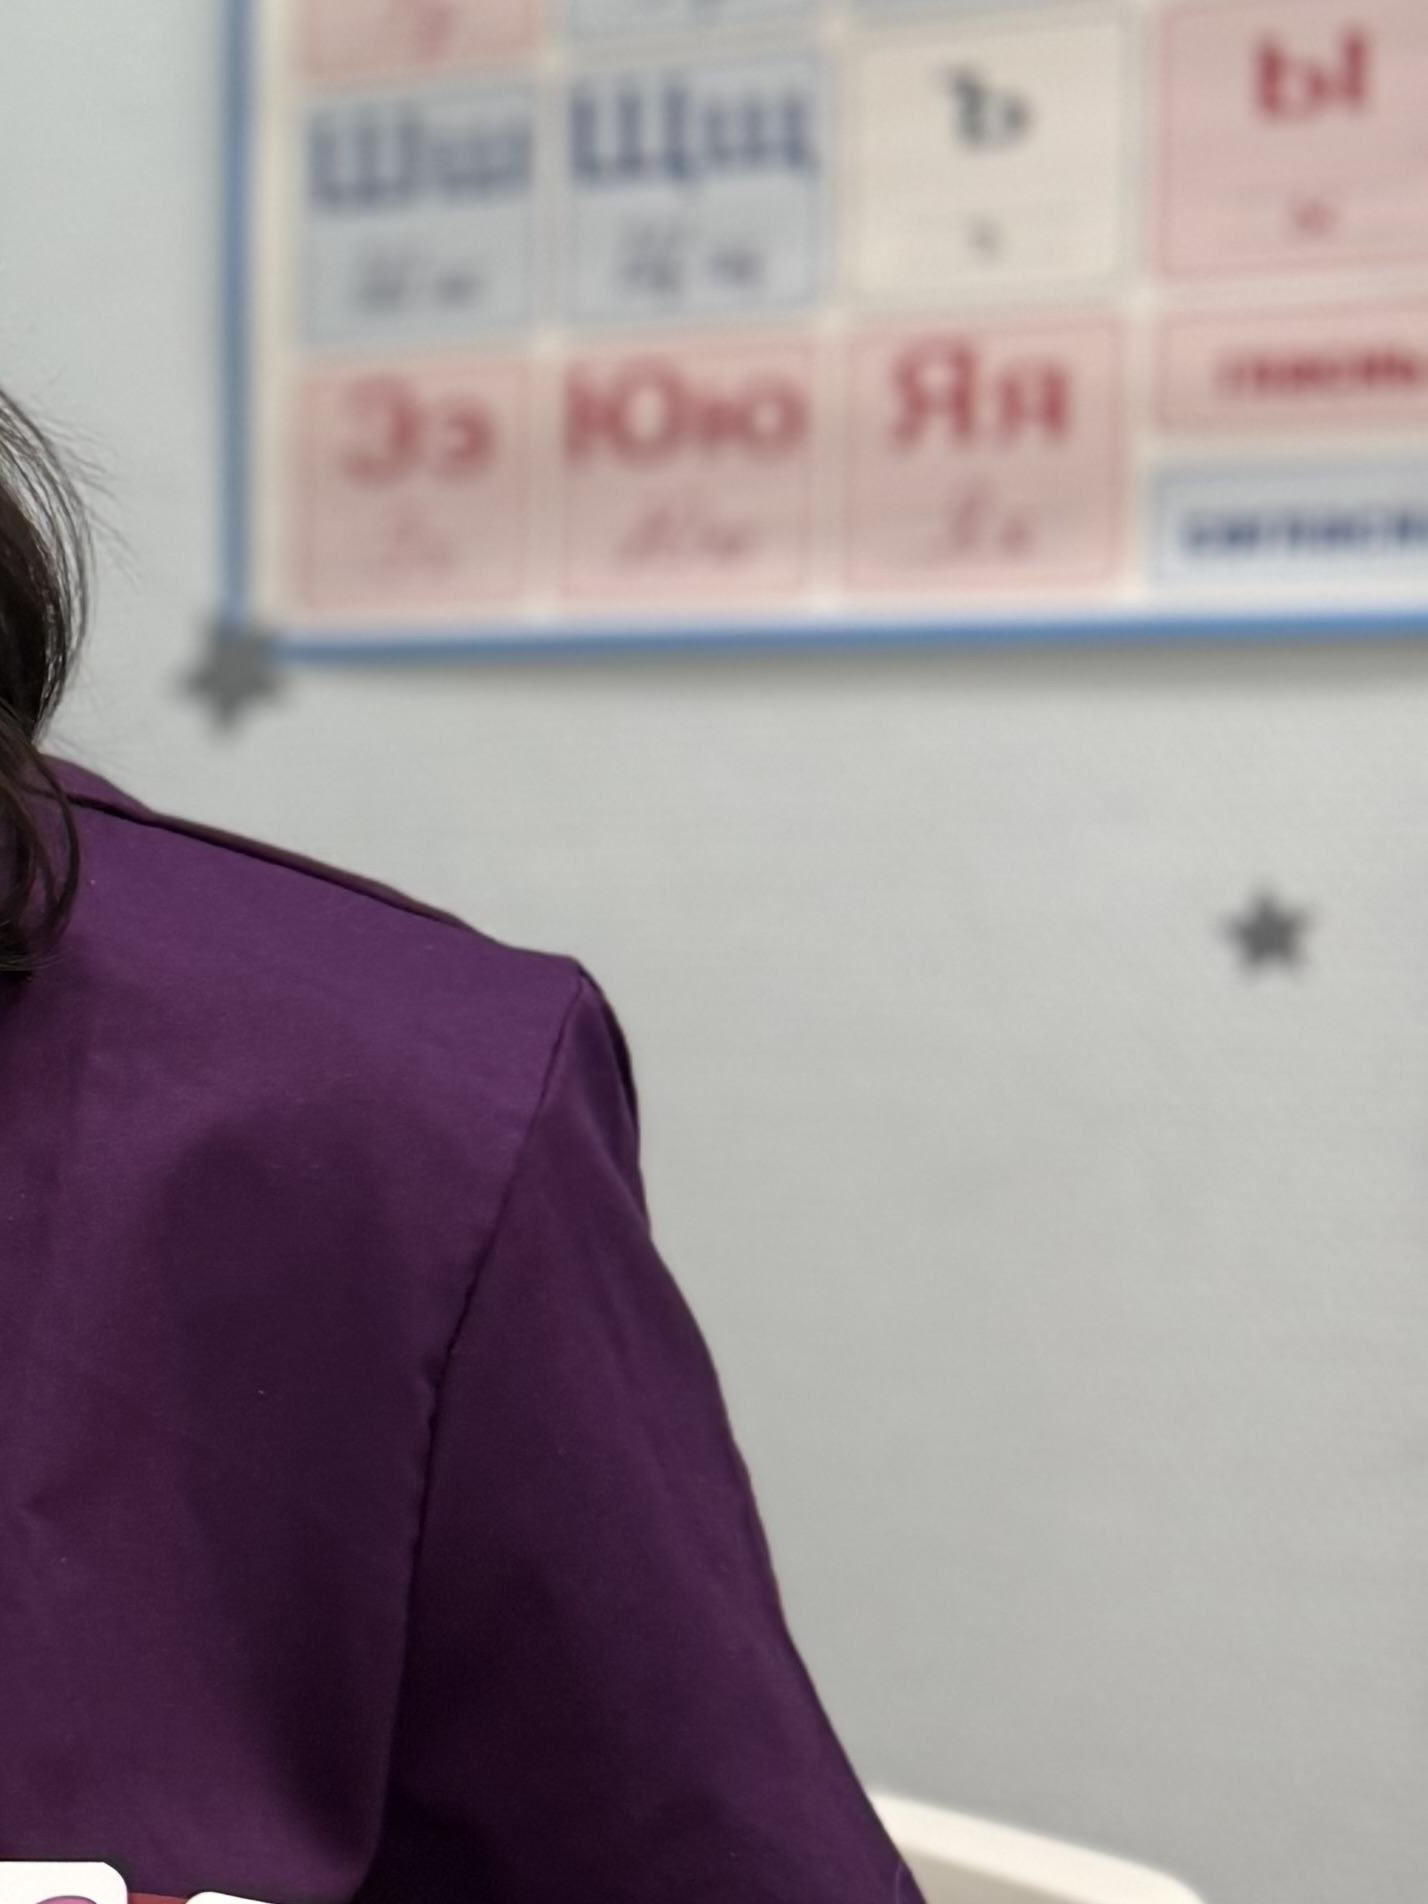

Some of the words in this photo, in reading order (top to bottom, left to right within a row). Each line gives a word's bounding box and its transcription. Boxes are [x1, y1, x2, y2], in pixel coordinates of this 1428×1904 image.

[304, 106, 534, 216] Шш
[565, 78, 818, 189] Щщ
[340, 380, 500, 488] Ээ
[560, 360, 810, 466] Юю
[889, 340, 1073, 452] Яя
